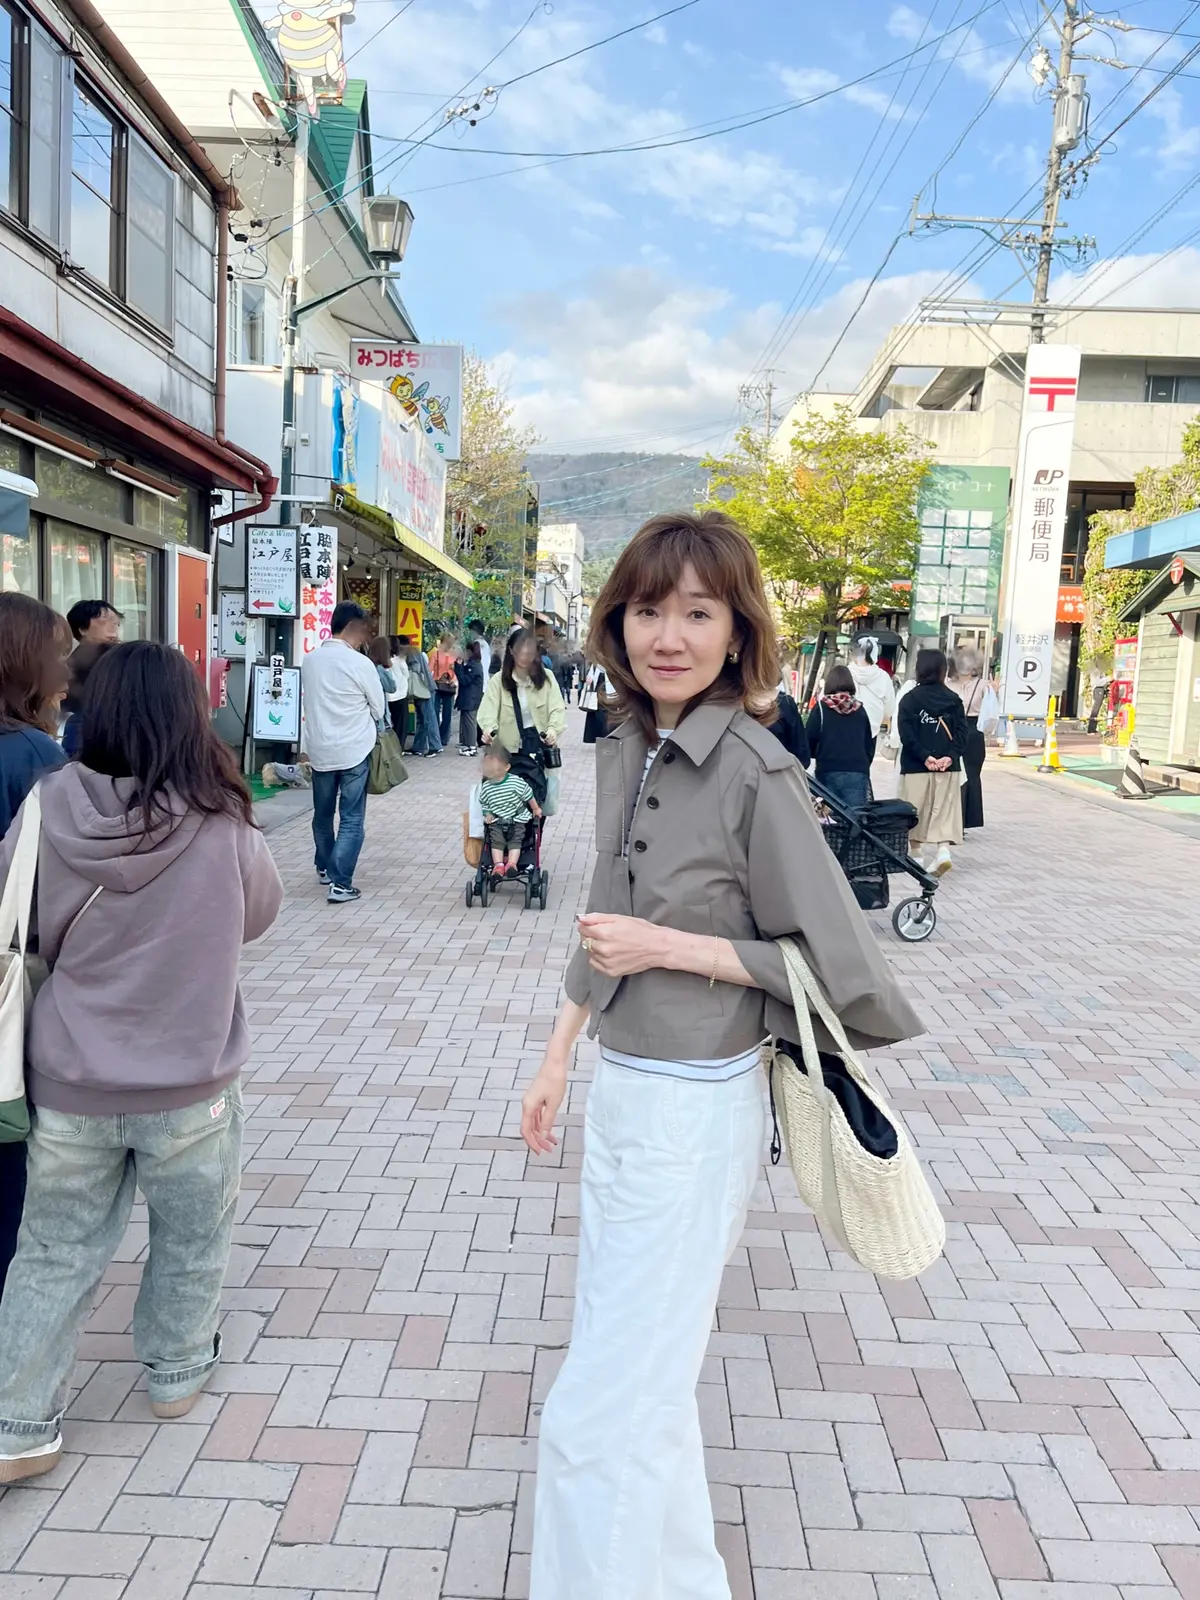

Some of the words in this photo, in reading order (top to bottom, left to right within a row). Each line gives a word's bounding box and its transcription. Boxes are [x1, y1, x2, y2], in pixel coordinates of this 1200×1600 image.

[357, 348, 456, 370] みつばち広
[1033, 469, 1064, 485] JP
[276, 530, 295, 538] Wine
[1028, 497, 1055, 563] 郵便局
[252, 546, 294, 563] 江戸屋
[316, 532, 332, 580] 脇本陣
[272, 658, 283, 688] 江戸屋
[1023, 660, 1037, 678] P
[261, 687, 293, 699] 江屋
